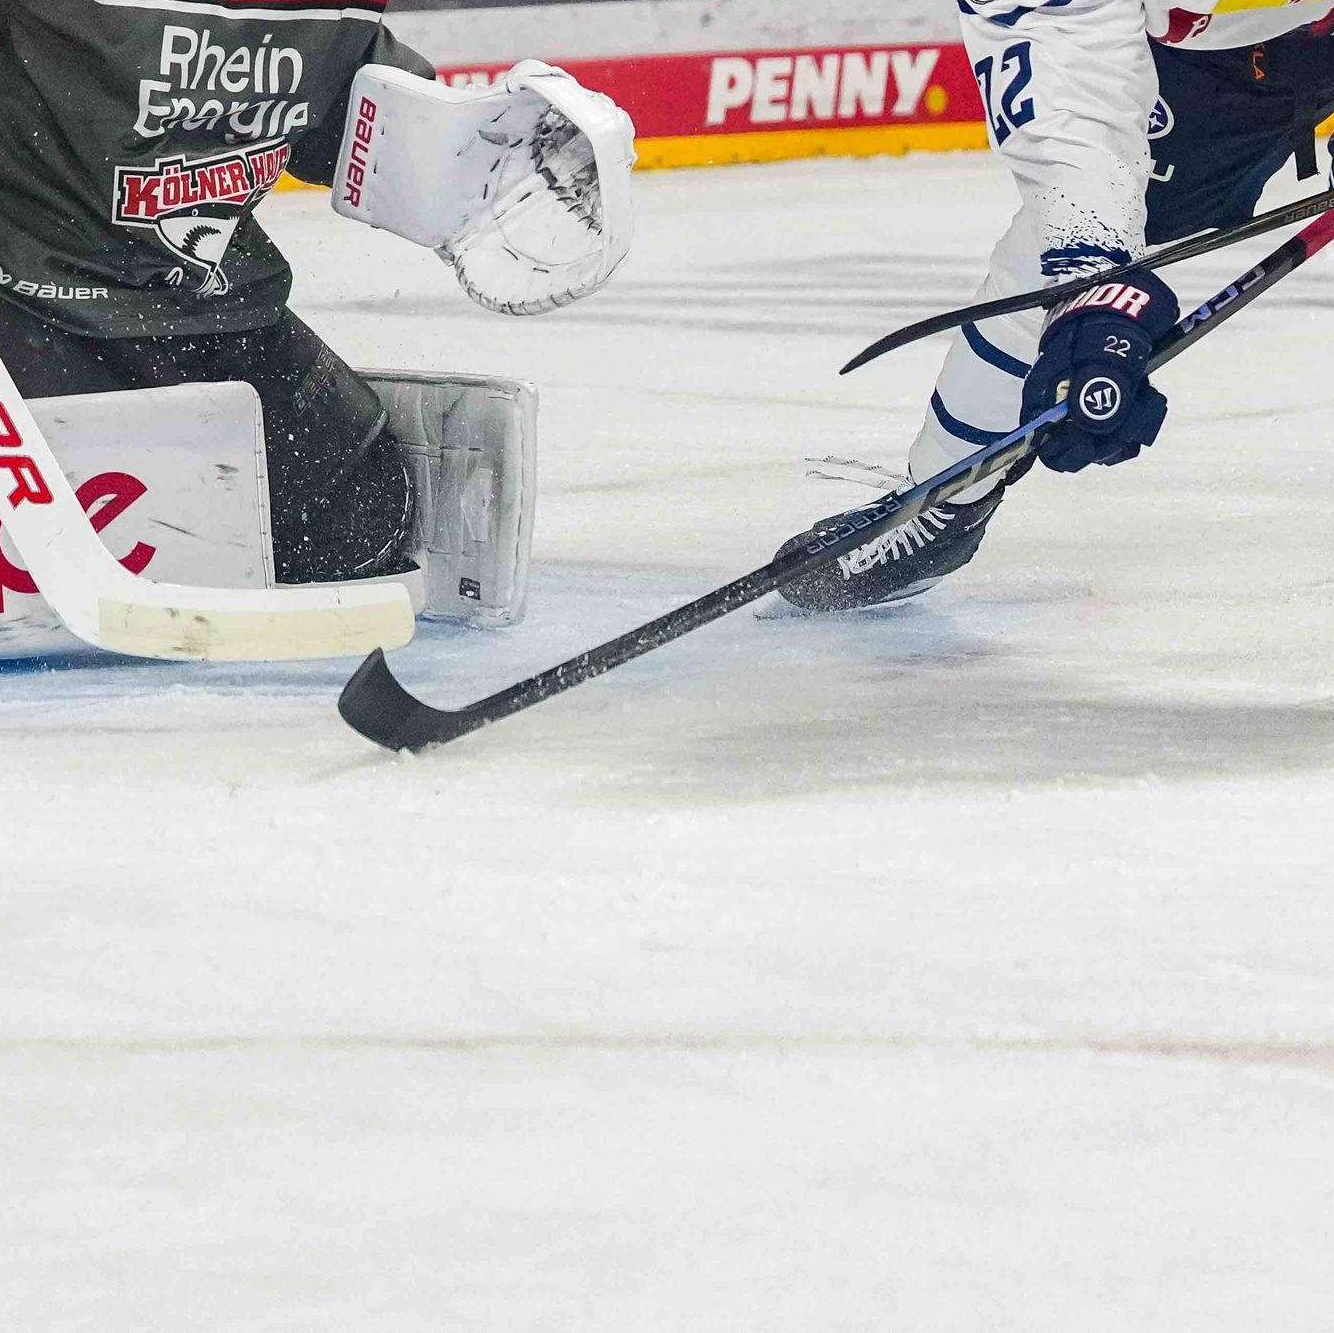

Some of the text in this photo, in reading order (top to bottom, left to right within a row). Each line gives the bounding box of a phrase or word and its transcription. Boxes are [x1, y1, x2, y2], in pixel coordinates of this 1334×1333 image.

[160, 25, 303, 94] Rhein
[974, 41, 1035, 146] 22
[343, 96, 378, 208] BAUER
[122, 158, 250, 216] KÖLNER
[12, 279, 108, 300] BAUER
[1183, 267, 1267, 334] CCM
[1104, 335, 1131, 358] 22
